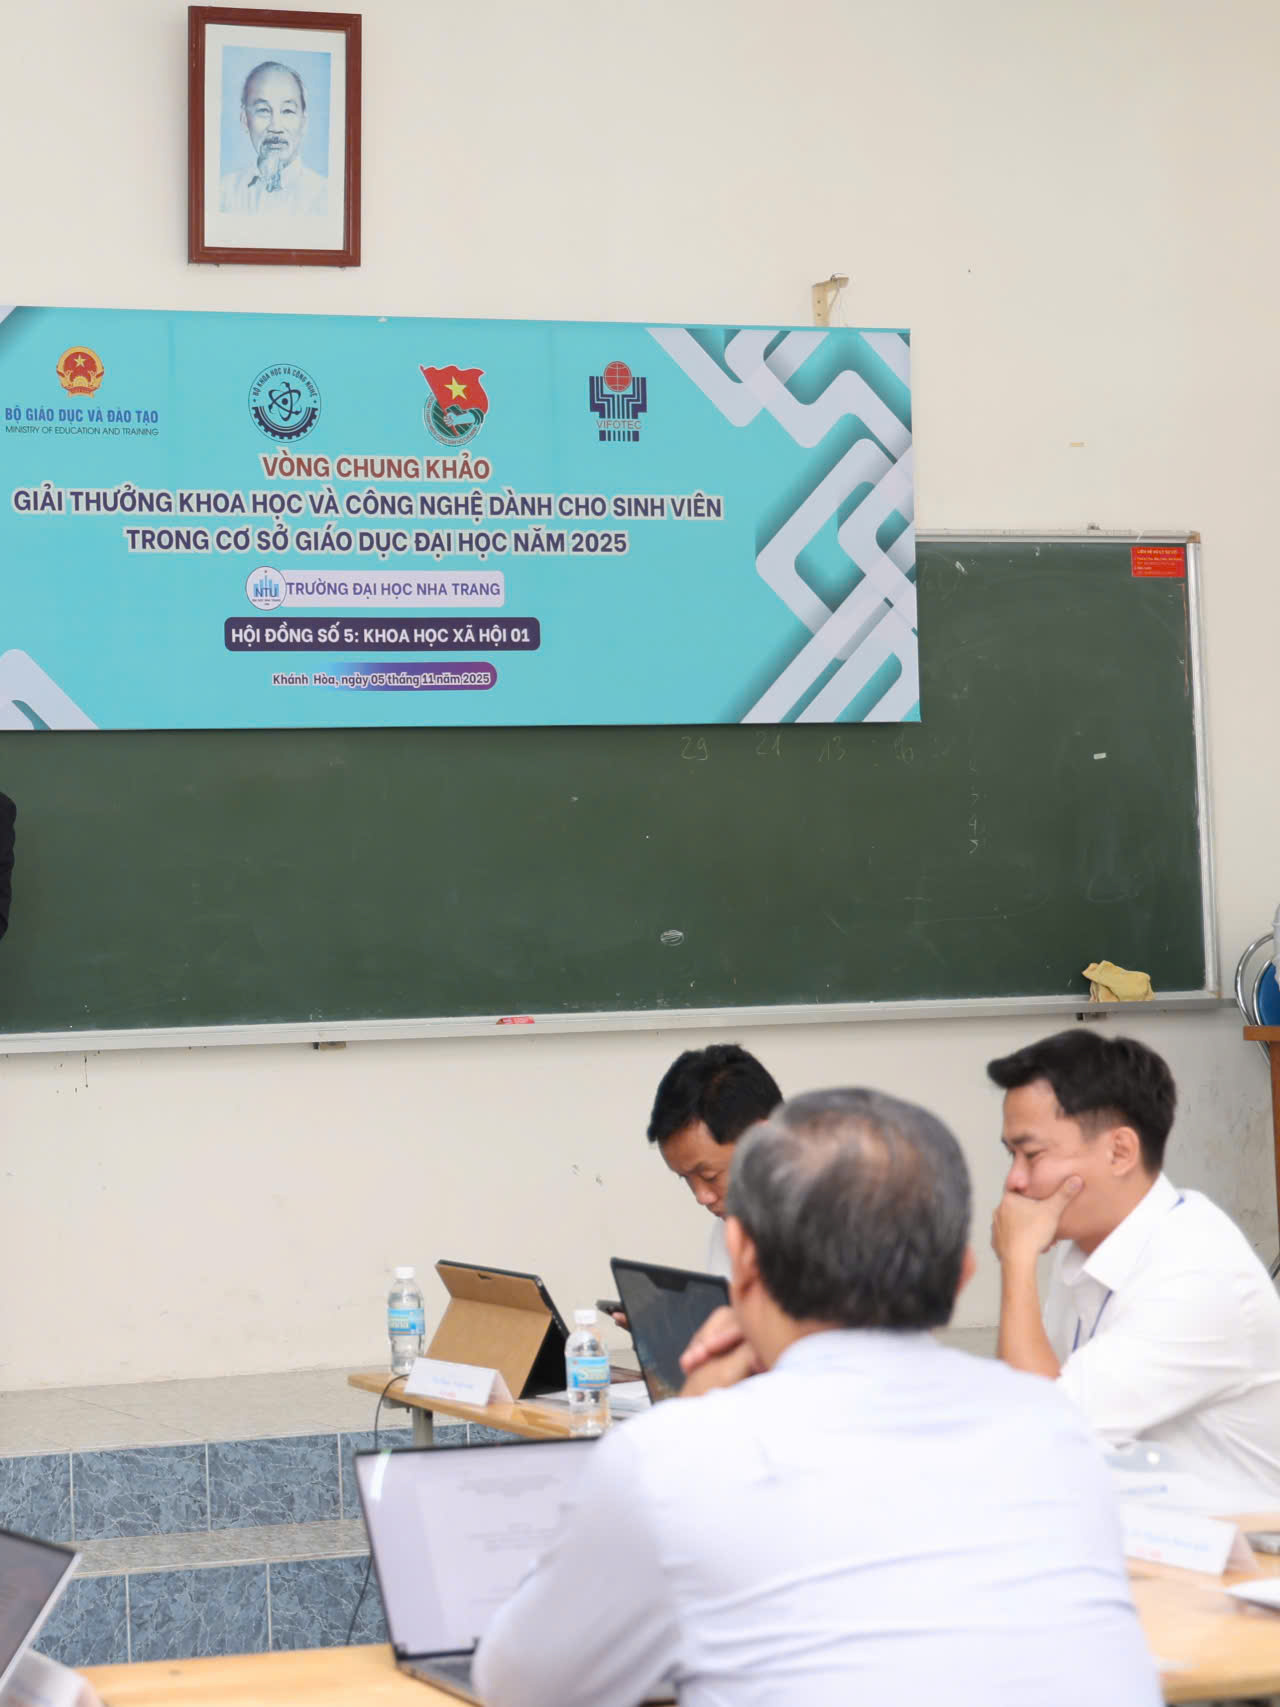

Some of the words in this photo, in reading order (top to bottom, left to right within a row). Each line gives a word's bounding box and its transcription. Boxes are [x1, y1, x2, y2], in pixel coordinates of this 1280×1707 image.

[5, 405, 22, 424] BỘ
[25, 405, 54, 421] GIÁO
[58, 408, 84, 425] DỤC
[87, 406, 103, 422] VÀ
[107, 407, 132, 423] ĐÀO
[135, 410, 159, 426] TẠO
[596, 419, 642, 430] VIFOTEC
[5, 426, 40, 434] MINISTRY
[41, 426, 53, 434] OF
[55, 426, 101, 435] EDUCATION
[102, 427, 121, 435] AND
[122, 427, 160, 436] TRAINING
[262, 450, 331, 478] VÒNG
[335, 457, 420, 479] CHUNG
[425, 452, 491, 480] KHẢO
[13, 483, 63, 511] GIẢI
[70, 484, 173, 513] THƯỞNG
[179, 492, 247, 513] KHOA
[252, 494, 303, 520] HỌC
[309, 487, 340, 514] VÀ
[345, 490, 414, 515] CÔNG
[419, 491, 484, 522] NGHỆ
[489, 489, 552, 517] DÀNH
[558, 496, 607, 517] CHO
[612, 497, 666, 518] SINH
[670, 493, 722, 518] VIÊN
[127, 529, 210, 550] TRONG
[216, 528, 250, 551] CƠ
[256, 524, 290, 552] SỞ
[295, 524, 353, 552] GIÁO
[359, 532, 408, 558] DỤC
[414, 532, 452, 559] ĐẠI
[458, 532, 507, 559] HỌC
[513, 527, 566, 552] NĂM
[571, 533, 627, 552] 2025
[255, 587, 278, 598] NTU
[286, 578, 349, 595] TRƯỜNG
[353, 582, 377, 599] ĐẠI
[381, 582, 413, 599] HỌC
[416, 583, 448, 596] NHA
[452, 583, 501, 596] TRANG
[231, 624, 261, 647] HỘI
[264, 621, 313, 643] ĐỒNG
[317, 621, 340, 643] SỐ
[344, 629, 359, 643] 5:
[363, 628, 410, 643] KHOA
[414, 628, 449, 647] HỌC
[453, 625, 476, 643] XÃ
[479, 624, 507, 647] HỘI
[510, 628, 530, 643] 01
[273, 673, 309, 685] Khánh
[313, 673, 339, 687] Hòa,
[341, 673, 369, 687] ngày
[371, 675, 385, 685] 05
[387, 672, 420, 687] tháng
[422, 674, 435, 684] 11
[436, 672, 461, 684] năm
[463, 673, 490, 684] 2025
